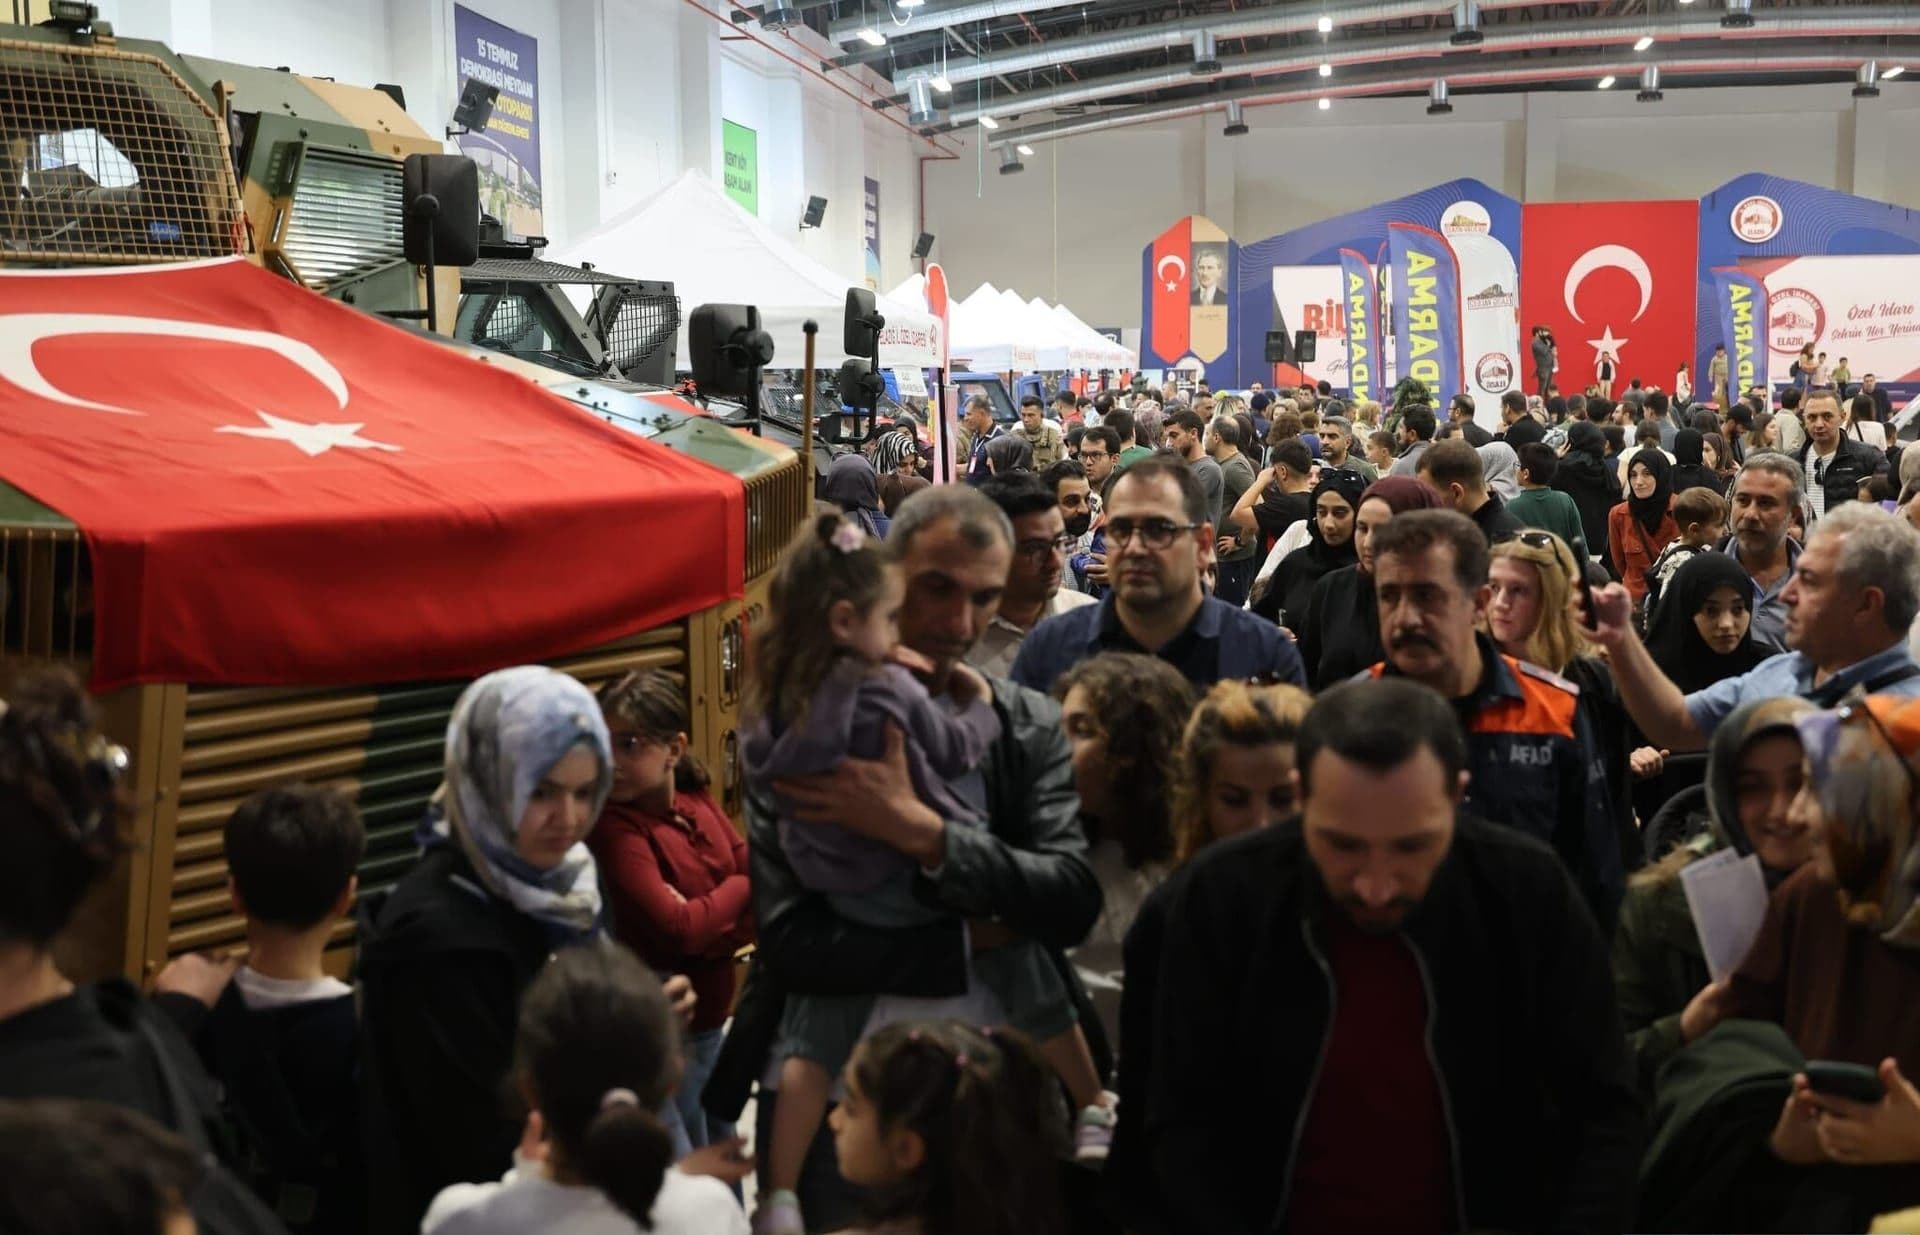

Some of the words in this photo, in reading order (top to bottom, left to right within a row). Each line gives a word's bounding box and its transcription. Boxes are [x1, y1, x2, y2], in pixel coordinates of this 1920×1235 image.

[477, 38, 486, 58] 15
[487, 41, 519, 71] TEMMUZ
[460, 56, 503, 88] DEMOKRASİ
[1777, 335, 1804, 346] ELAZIĞ
[1509, 743, 1552, 766] AFAD
